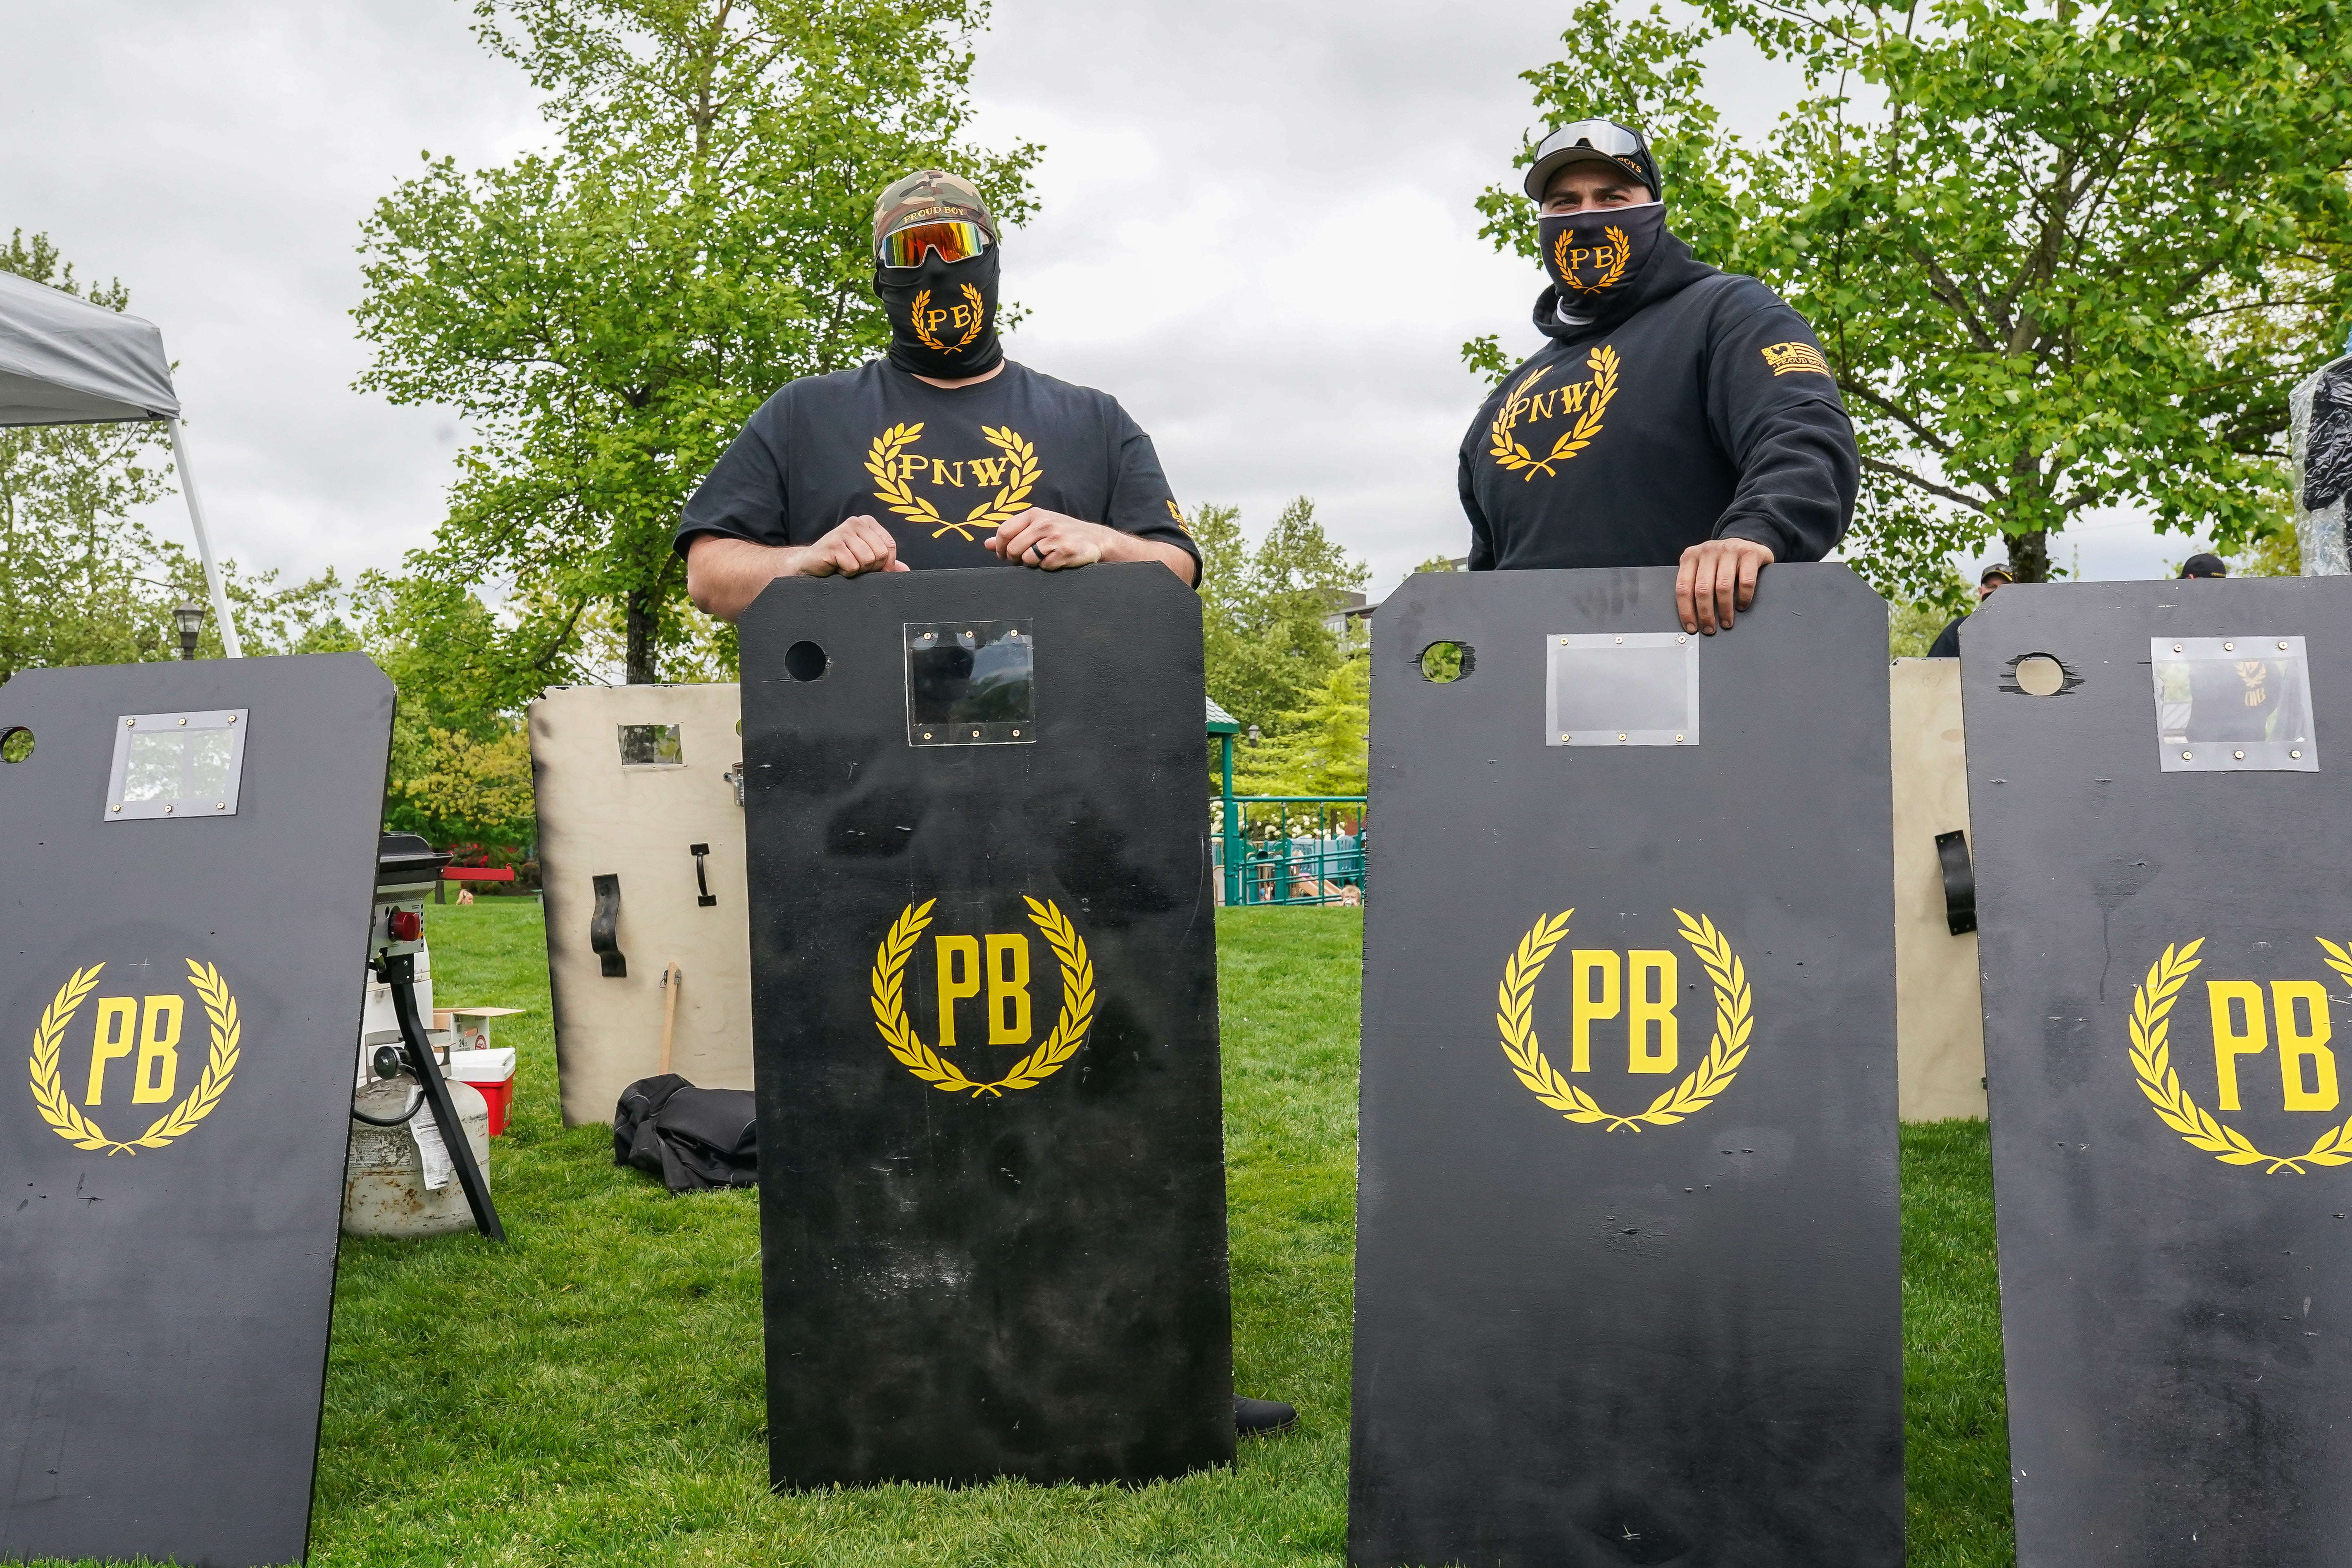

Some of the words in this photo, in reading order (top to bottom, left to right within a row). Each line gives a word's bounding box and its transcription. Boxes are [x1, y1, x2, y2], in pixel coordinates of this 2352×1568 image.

[903, 206, 941, 224] PROUD
[943, 206, 964, 216] BOY
[1570, 246, 1614, 270] PB
[927, 304, 972, 331] PB
[1775, 357, 1807, 367] PROUD
[1506, 380, 1594, 429] PNW
[898, 454, 1009, 488] PNW
[934, 933, 1032, 1047] PB
[1570, 949, 1678, 1075] PB
[84, 994, 184, 1106] PB
[2206, 980, 2340, 1112] PB
